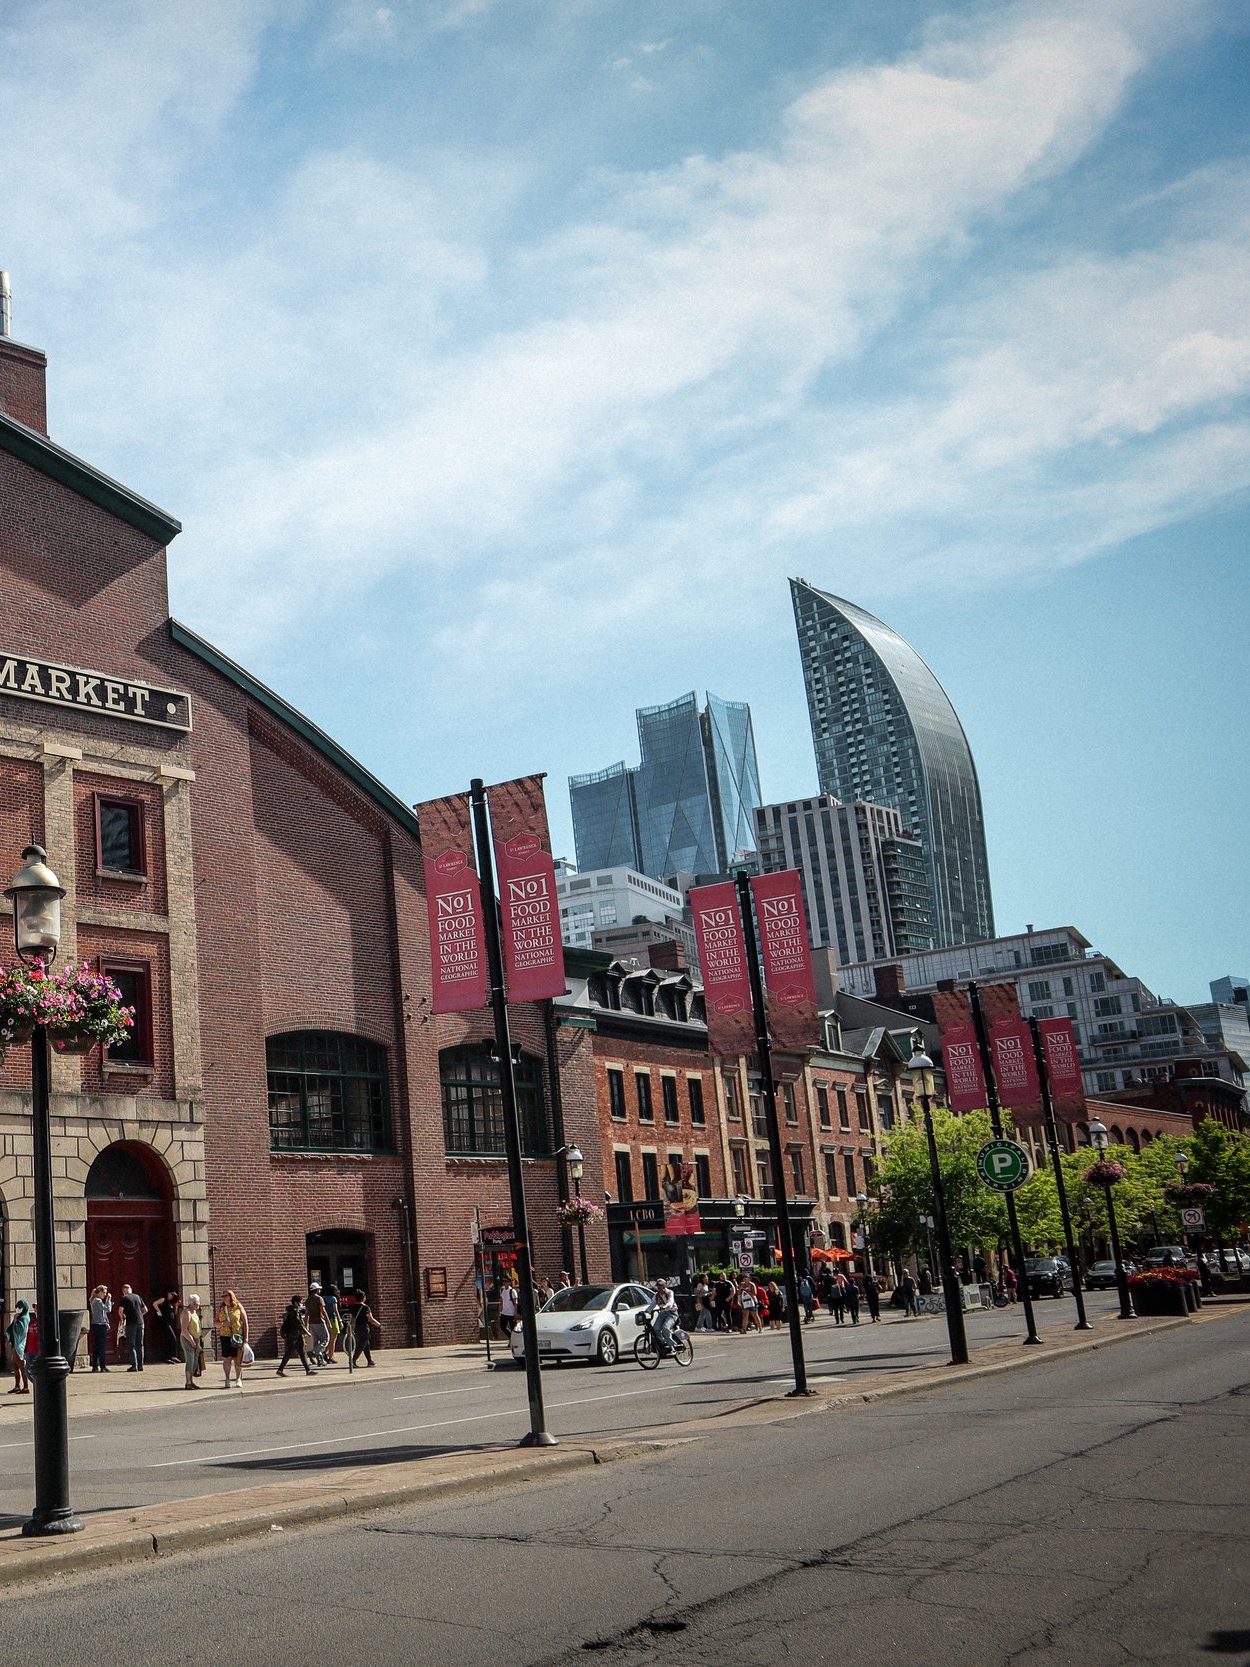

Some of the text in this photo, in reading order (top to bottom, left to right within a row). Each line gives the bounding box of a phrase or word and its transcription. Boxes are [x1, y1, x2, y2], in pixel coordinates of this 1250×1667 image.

[510, 900, 550, 918] FOOD
[438, 915, 475, 932] FOOD
[512, 913, 551, 927] MARKET
[765, 916, 800, 931] FOOD
[438, 928, 476, 942] MARKET
[513, 925, 553, 941] IN THE
[703, 928, 737, 942] FOOD
[766, 926, 801, 940] MARKET
[439, 940, 477, 954] IN THE
[514, 936, 554, 950] WORLD
[704, 938, 738, 950] MARKET
[768, 937, 802, 950] IN THE
[440, 950, 478, 964] WORLD
[514, 949, 554, 961] NATIONAL
[706, 948, 740, 960] IN THE
[769, 946, 803, 958] WORLD
[440, 962, 478, 974] NATIONAL
[515, 956, 555, 968] GEOGRAPHIC
[707, 956, 741, 968] WORLD
[770, 956, 804, 967] NATIONAL
[440, 970, 478, 981] GEOGRAPHIC
[708, 966, 742, 977] NATIONAL
[998, 1050, 1024, 1060] FOOD
[1048, 1044, 1072, 1054] FOOD
[950, 1058, 975, 1066] FOOD
[978, 1142, 1026, 1166] MUNICIPAL
[992, 1153, 1012, 1174] P
[980, 1168, 1027, 1190] PARKING
[630, 1208, 655, 1220] LCBO
